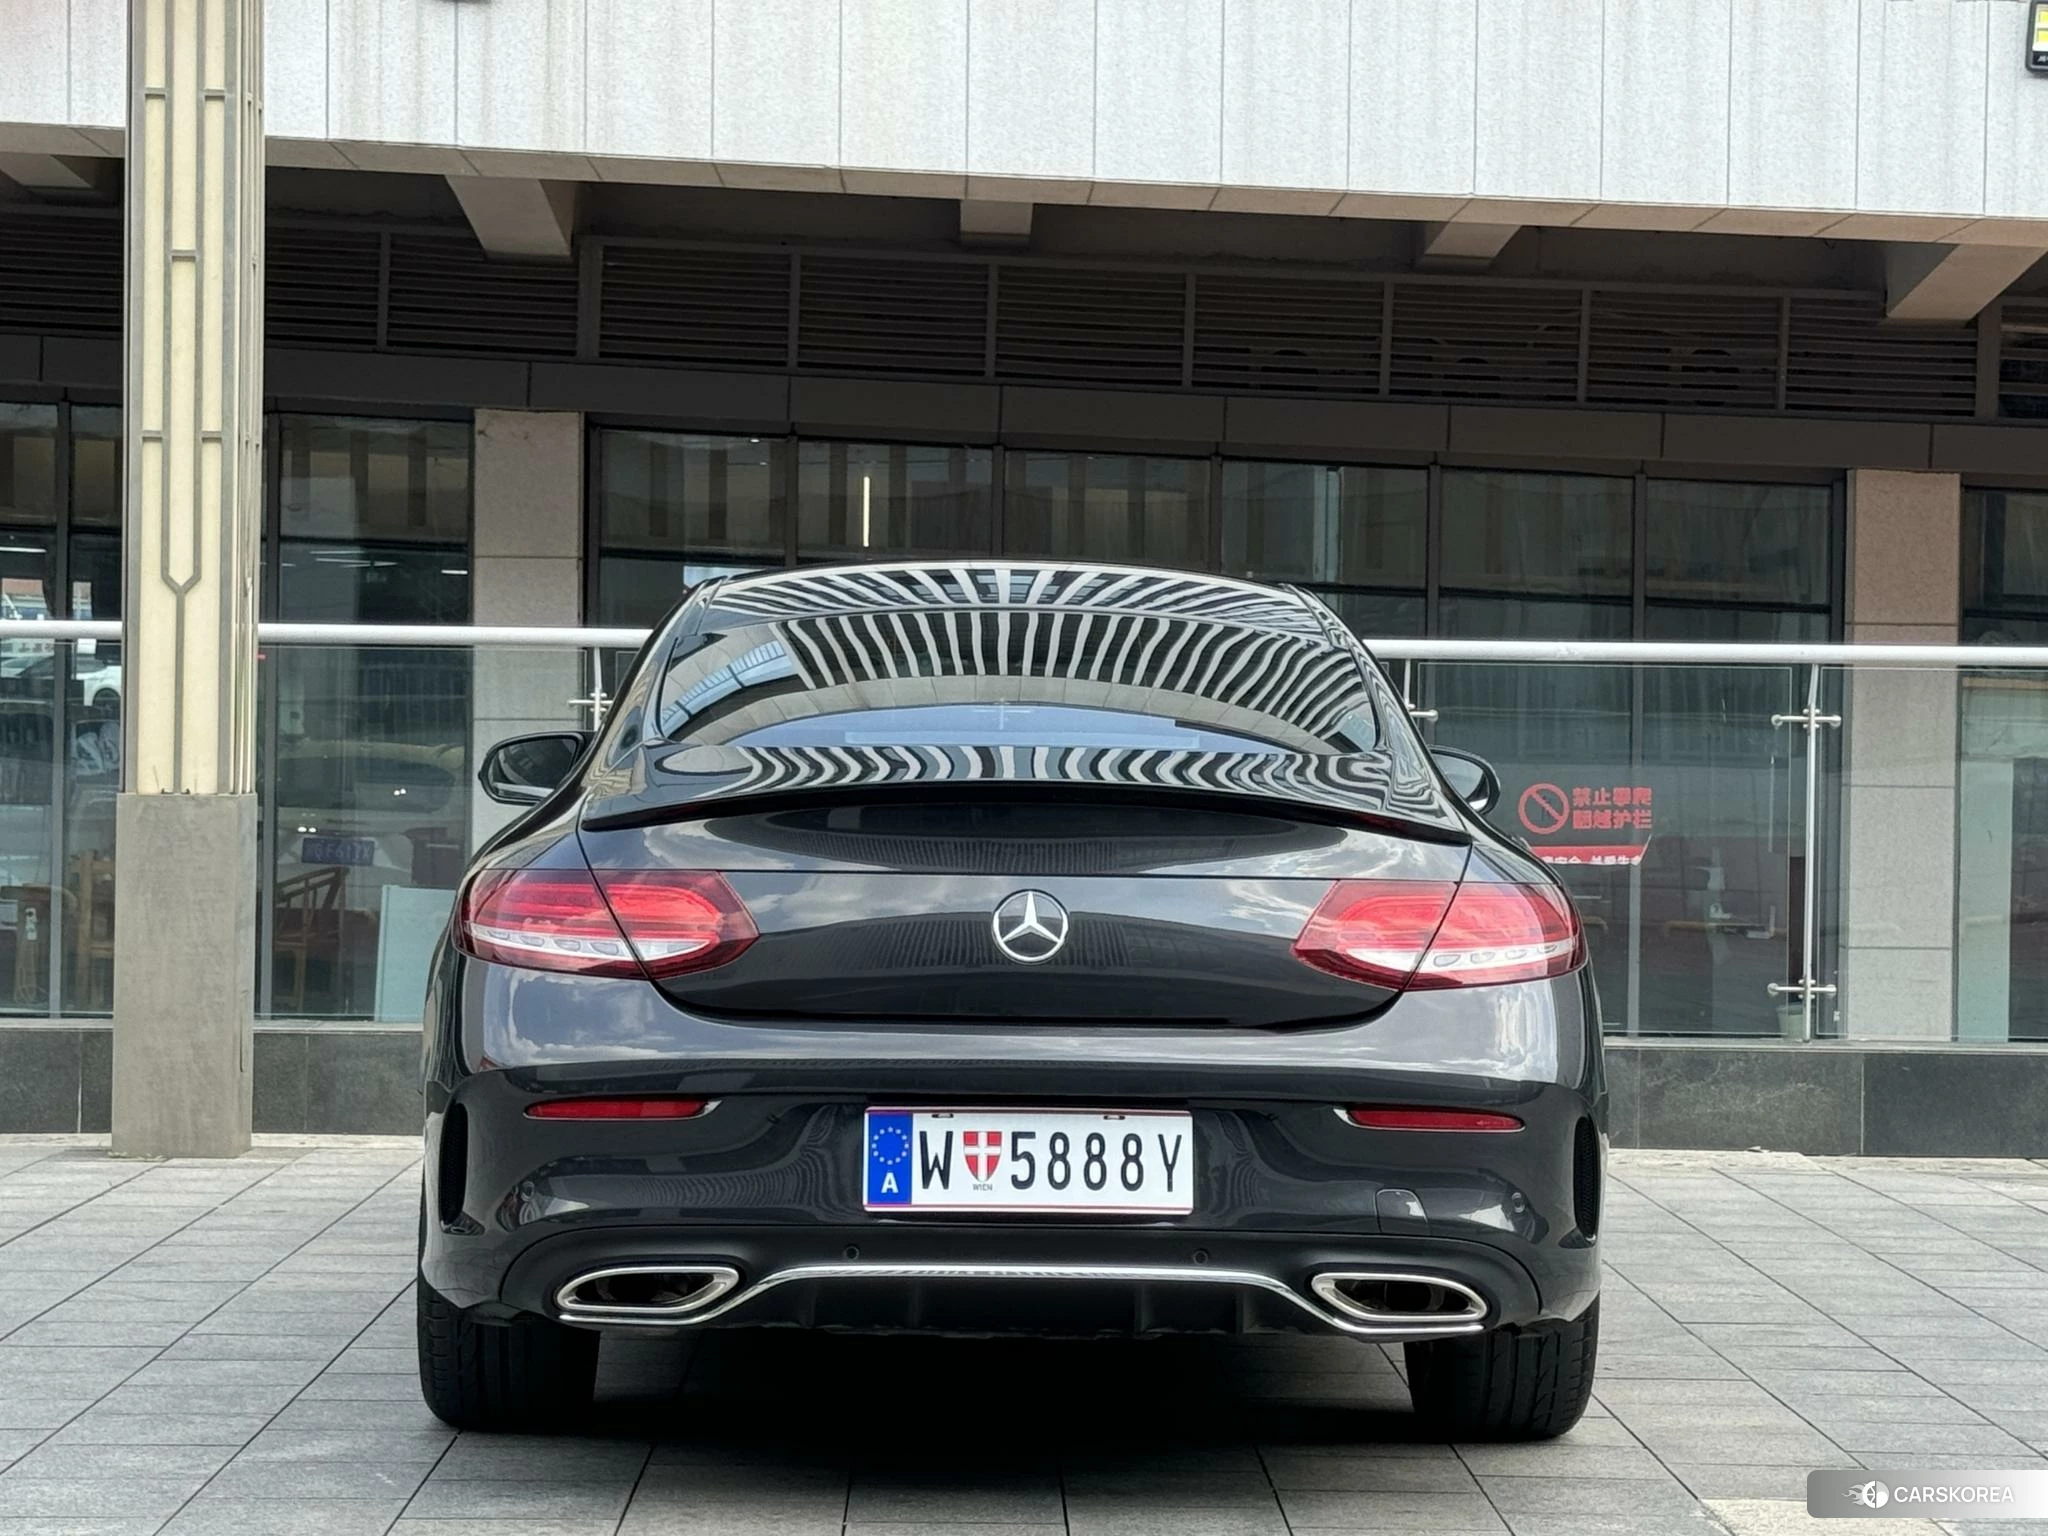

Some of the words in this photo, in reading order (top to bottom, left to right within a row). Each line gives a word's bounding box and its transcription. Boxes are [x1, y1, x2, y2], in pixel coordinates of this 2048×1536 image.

[919, 1131, 954, 1190] W
[1011, 1131, 1183, 1192] 5888Y
[880, 1172, 899, 1194] A
